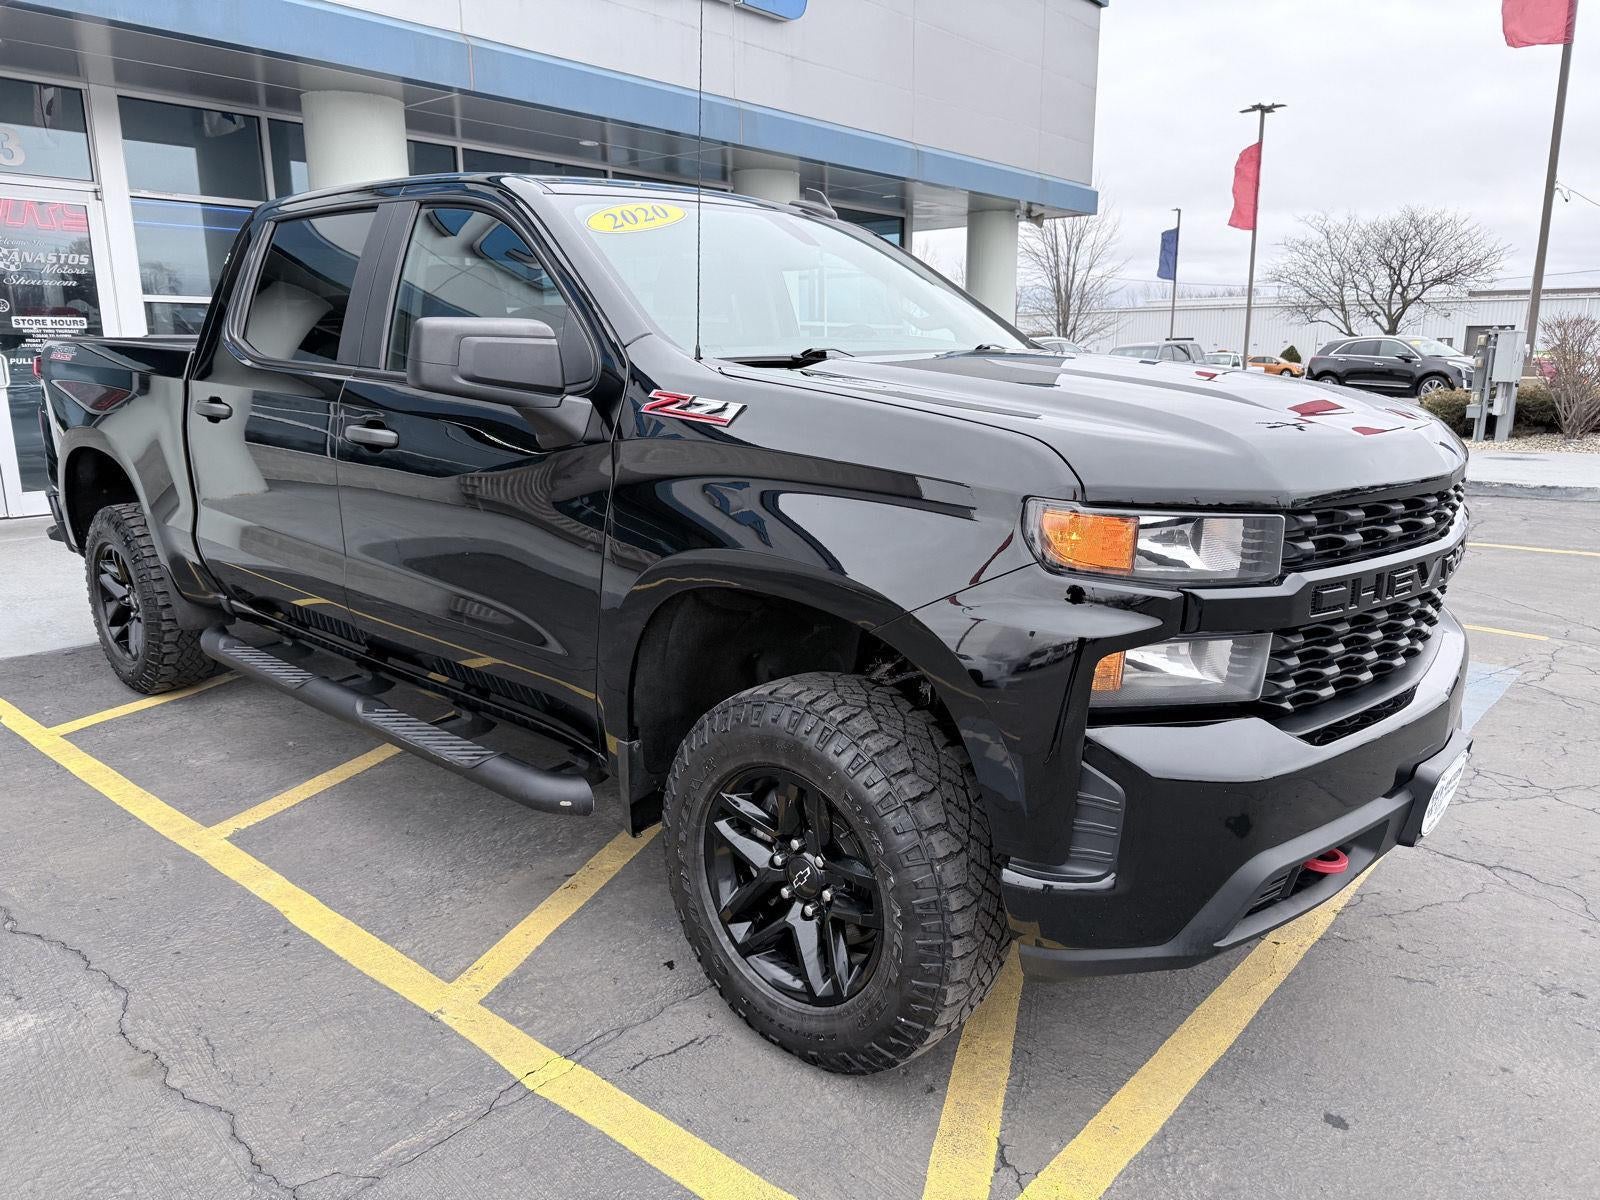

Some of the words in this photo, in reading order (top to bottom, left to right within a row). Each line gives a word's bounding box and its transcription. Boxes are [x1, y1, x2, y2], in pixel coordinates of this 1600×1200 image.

[603, 205, 671, 231] 2020
[0, 235, 29, 246] elcome
[8, 250, 90, 265] ANASTOS
[41, 264, 88, 275] Motors
[3, 274, 79, 287] Showroom
[14, 318, 47, 326] STORE
[51, 319, 86, 327] HOURS
[9, 357, 33, 365] PULL
